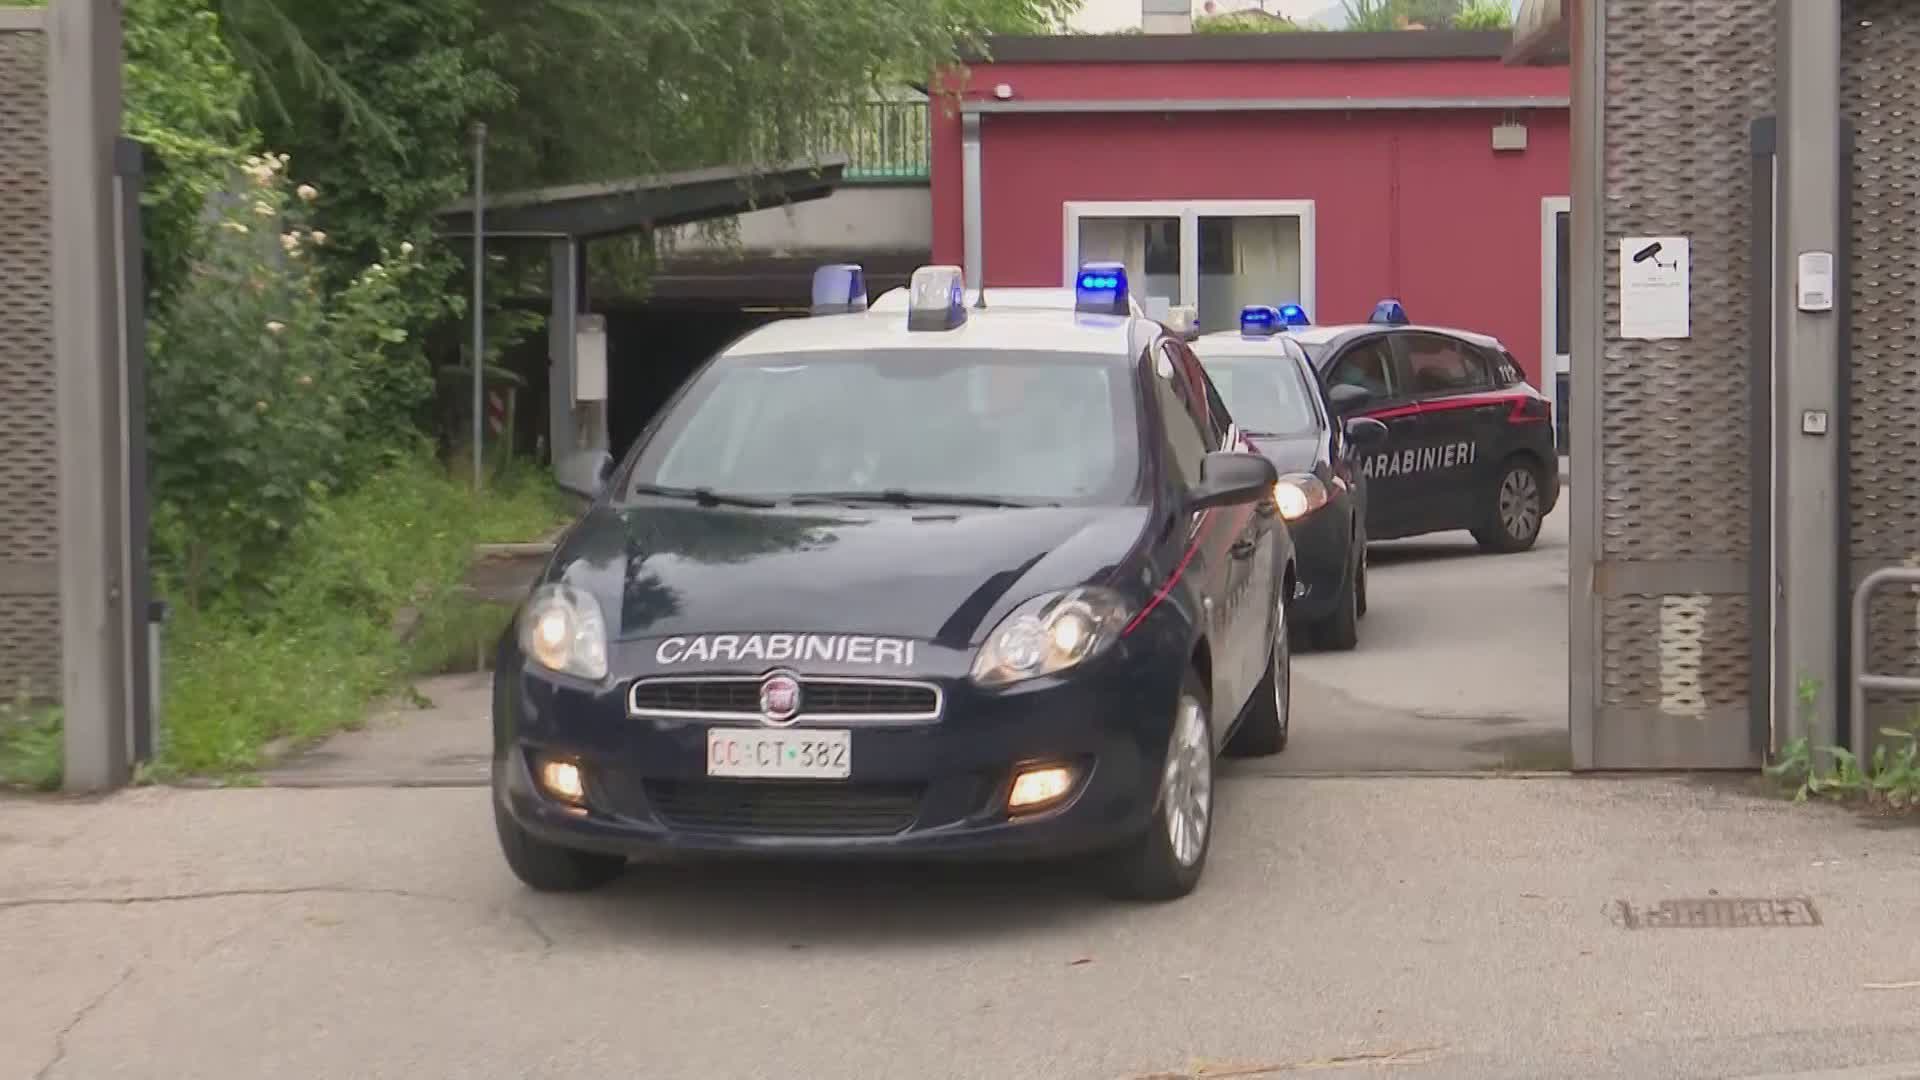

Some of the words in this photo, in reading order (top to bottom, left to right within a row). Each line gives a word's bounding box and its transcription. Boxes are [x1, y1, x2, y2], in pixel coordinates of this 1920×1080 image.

[1363, 441, 1476, 479] ARABINIERI
[655, 633, 915, 665] CARABINIERI
[800, 742, 847, 768] 382
